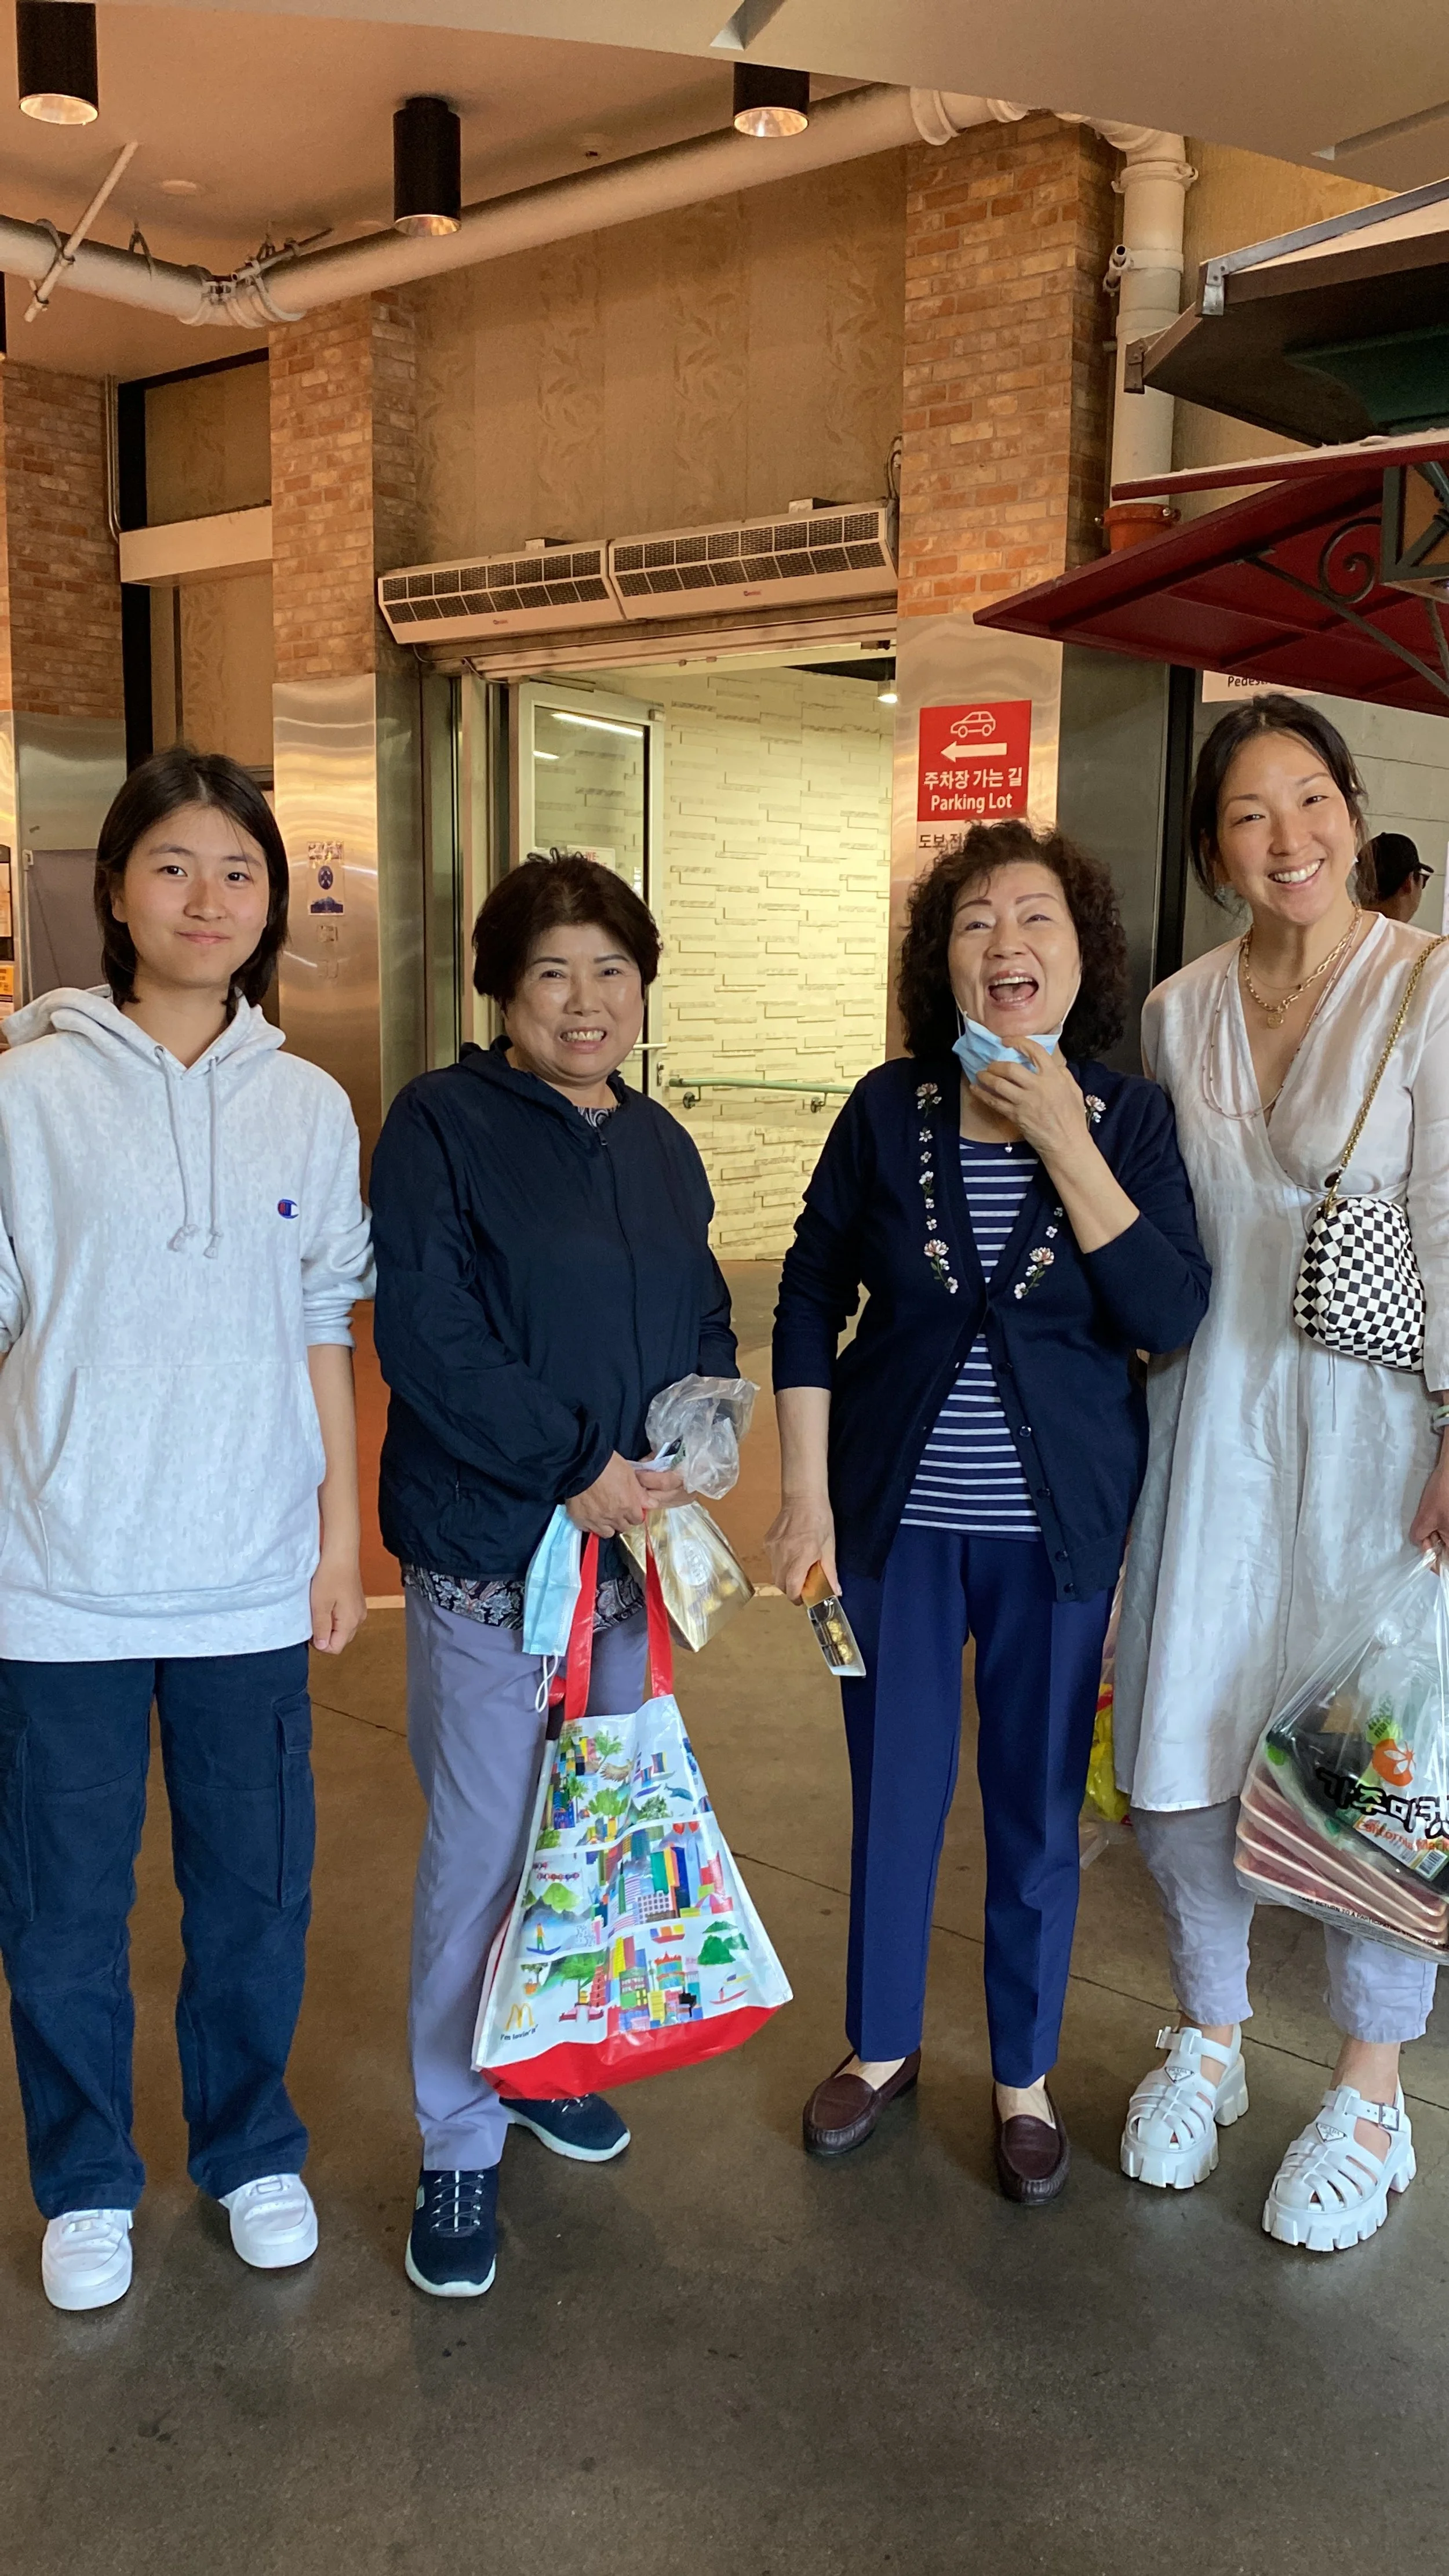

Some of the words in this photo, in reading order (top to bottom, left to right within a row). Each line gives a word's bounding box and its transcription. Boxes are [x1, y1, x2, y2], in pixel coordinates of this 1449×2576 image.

[1228, 676, 1268, 687] Pede
[924, 770, 969, 790] 주차장
[973, 769, 1004, 788] 가는
[1008, 767, 1022, 787] 길
[931, 794, 985, 813] Parking
[989, 792, 1013, 809] Lot
[919, 834, 946, 849] 도보
